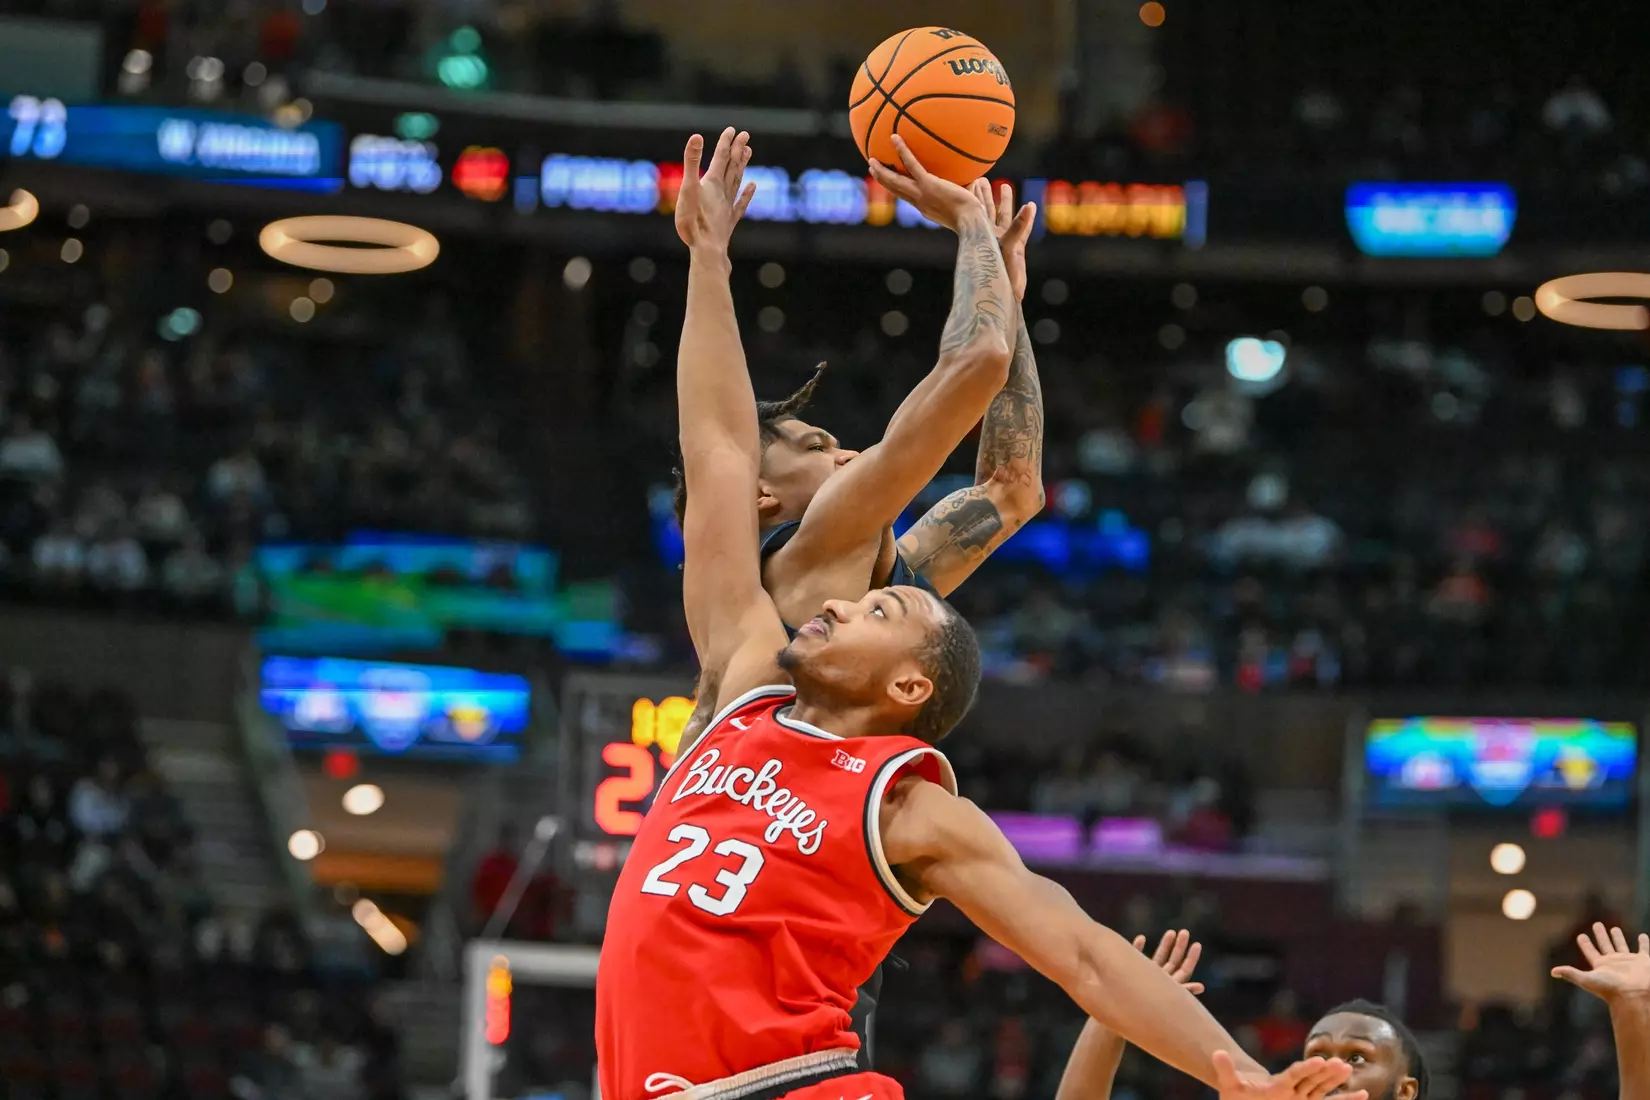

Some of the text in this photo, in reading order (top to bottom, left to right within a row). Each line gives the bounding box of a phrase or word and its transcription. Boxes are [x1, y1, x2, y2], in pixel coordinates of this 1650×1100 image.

[595, 742, 675, 836] 2
[671, 748, 828, 855] Buckeyes
[640, 823, 765, 917] 23
